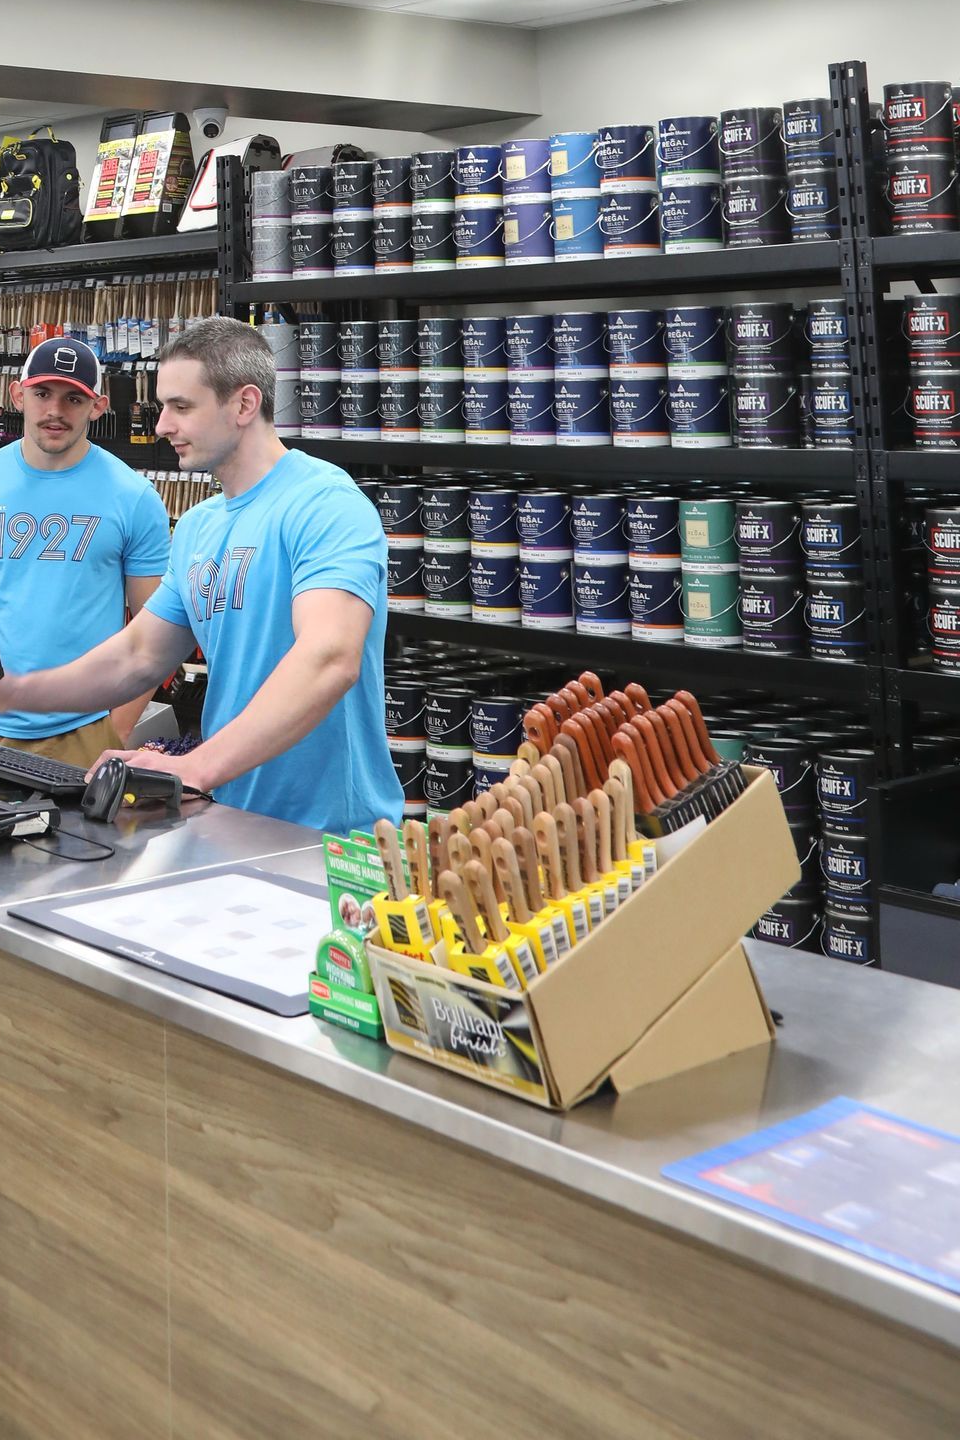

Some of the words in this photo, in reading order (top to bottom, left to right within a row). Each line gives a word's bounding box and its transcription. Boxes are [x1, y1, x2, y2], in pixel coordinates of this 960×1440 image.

[889, 103, 921, 119] SCUFF-X
[787, 119, 817, 135] SCUFF-X
[724, 128, 751, 143] SCUFF-X
[893, 179, 926, 195] SCUFF-X
[728, 198, 756, 213] SCUFF-X
[793, 192, 824, 207] SCUFF-X
[737, 324, 769, 337] SCUFF-X
[812, 321, 842, 335] SCUFF-X
[910, 316, 944, 331] SCUFF-X
[738, 395, 766, 410] SCUFF-X
[815, 396, 846, 410] SCUFF-X
[916, 395, 950, 409] SCUFF-X
[740, 525, 769, 539] SCUFF-X
[807, 529, 838, 542] SCUFF-X
[934, 533, 960, 548] SCUFF
[743, 599, 770, 614] SCUFF-X
[811, 605, 839, 620] SCUFF-X
[934, 612, 960, 629] SCUFF-
[385, 711, 402, 719] URA
[821, 777, 851, 796] SCUFF-X
[328, 856, 361, 876] WORKING
[361, 867, 385, 883] HANDS
[828, 857, 860, 876] SCUFF-X
[759, 918, 789, 938] SCUFF-X
[830, 936, 863, 957] SCUFF-X
[326, 961, 355, 986] WORKING
[432, 998, 507, 1042] Brilliant
[450, 1023, 505, 1056] finish
